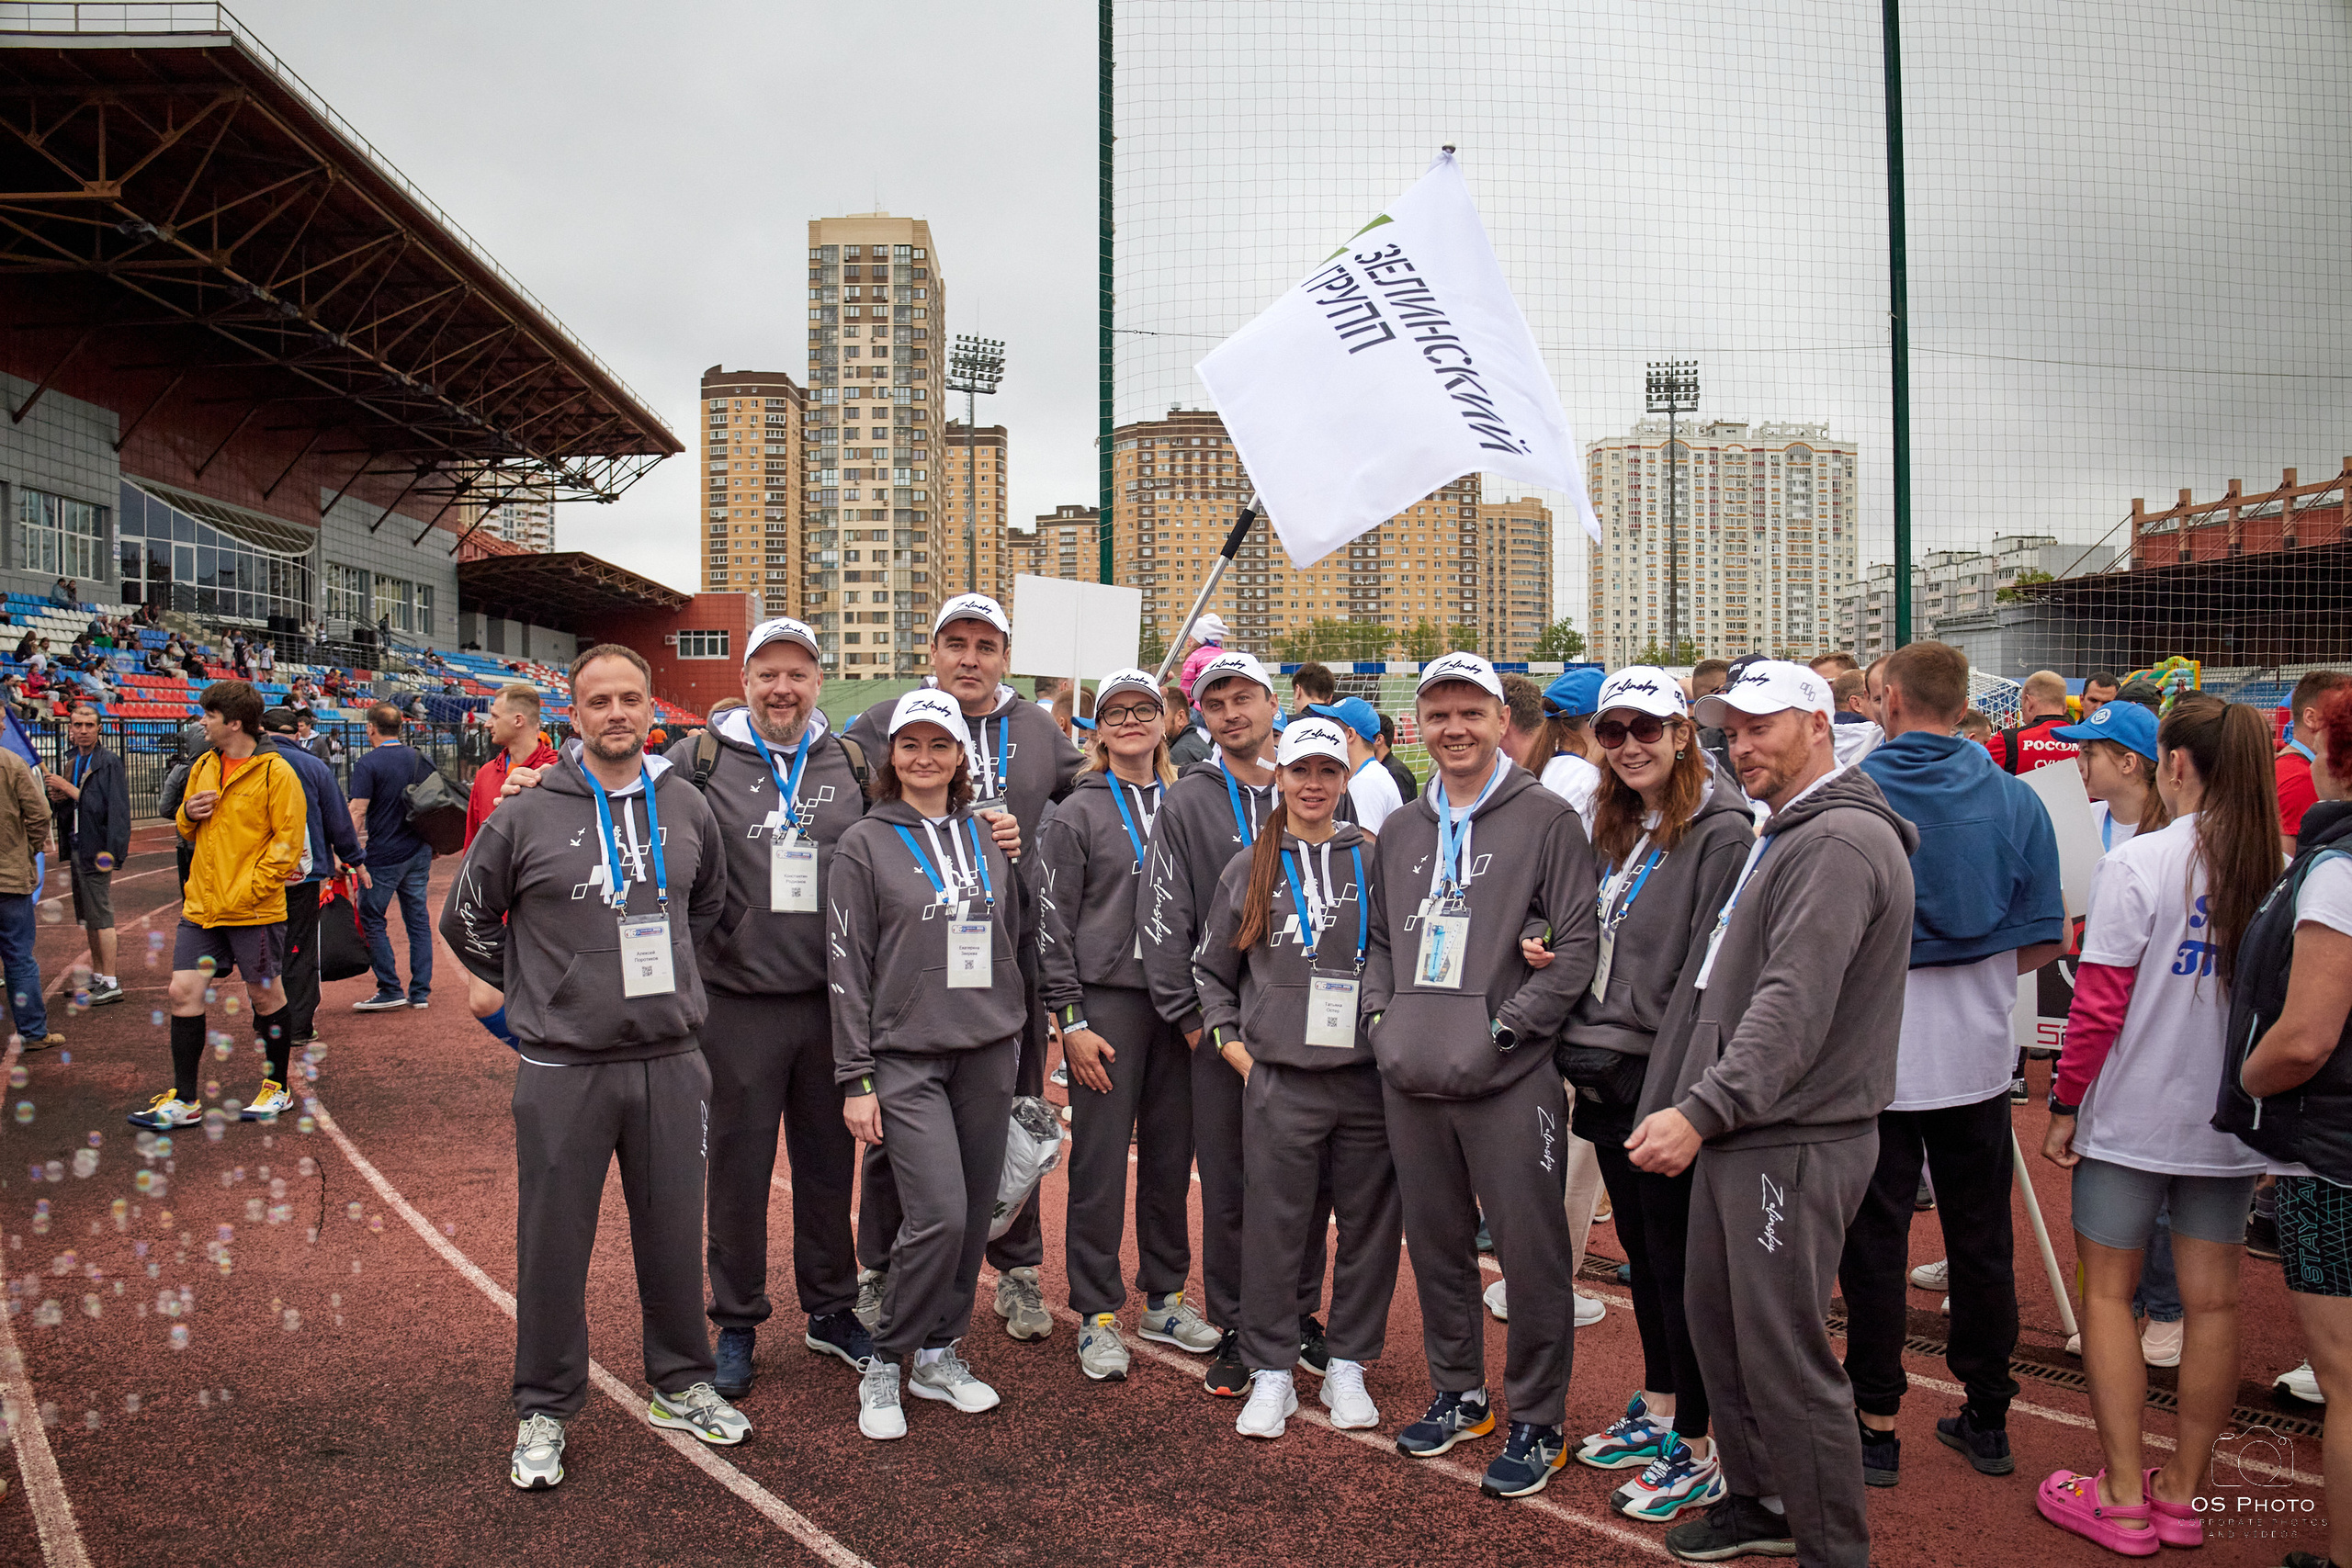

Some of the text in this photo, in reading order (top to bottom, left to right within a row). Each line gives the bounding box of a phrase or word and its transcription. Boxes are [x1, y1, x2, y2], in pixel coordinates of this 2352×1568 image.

[1300, 263, 1396, 355] ГРУПП
[1353, 243, 1532, 457] ЗЕЛИНСКИЙ
[1433, 659, 1483, 676] Zelinsky
[1602, 678, 1659, 705] Zelinsky
[905, 700, 953, 717] Zelinsky
[1294, 728, 1340, 746] Zelinsky
[1144, 840, 1173, 946] Zelinsky
[1536, 1105, 1555, 1173] Zelinsky
[1758, 1172, 1784, 1254] Zelinsky
[2298, 1210, 2324, 1284] STAY
